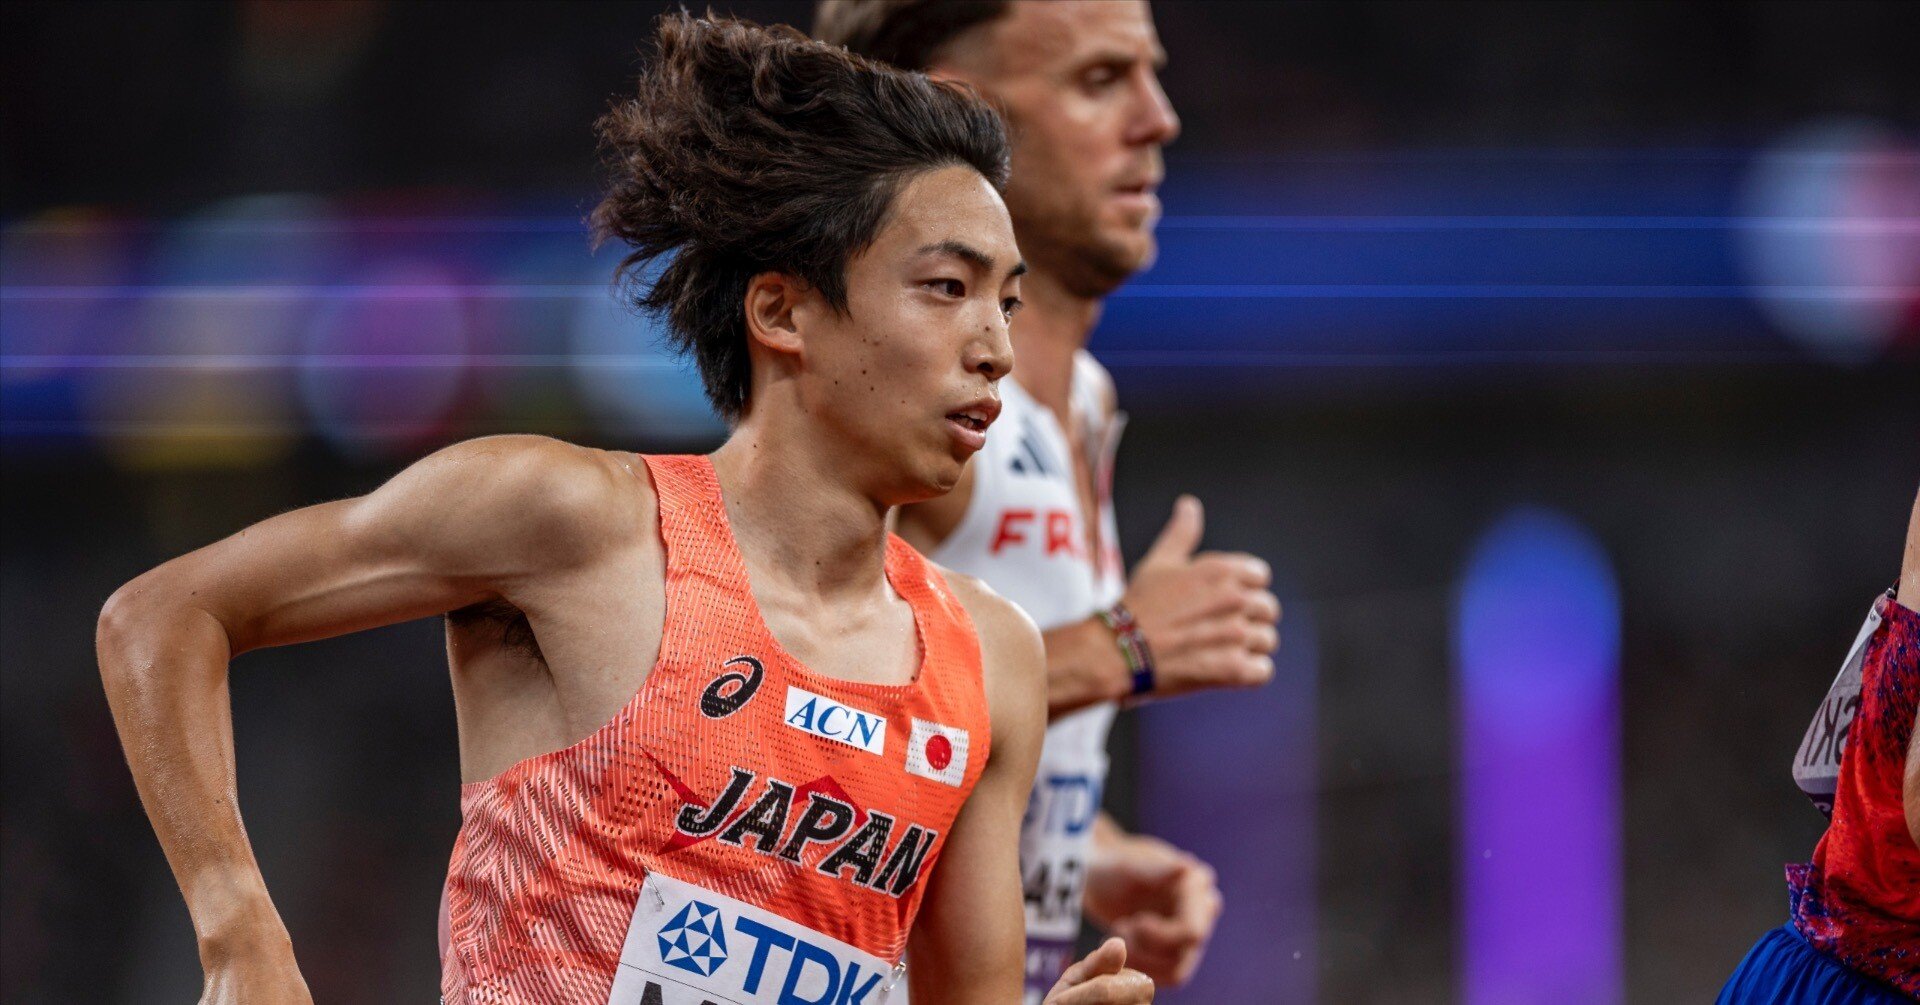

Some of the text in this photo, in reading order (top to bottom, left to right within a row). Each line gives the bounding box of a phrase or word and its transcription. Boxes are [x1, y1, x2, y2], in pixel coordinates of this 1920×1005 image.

[787, 697, 883, 747] ACN
[676, 766, 937, 897] JAPAN
[735, 915, 883, 1005] TDK
